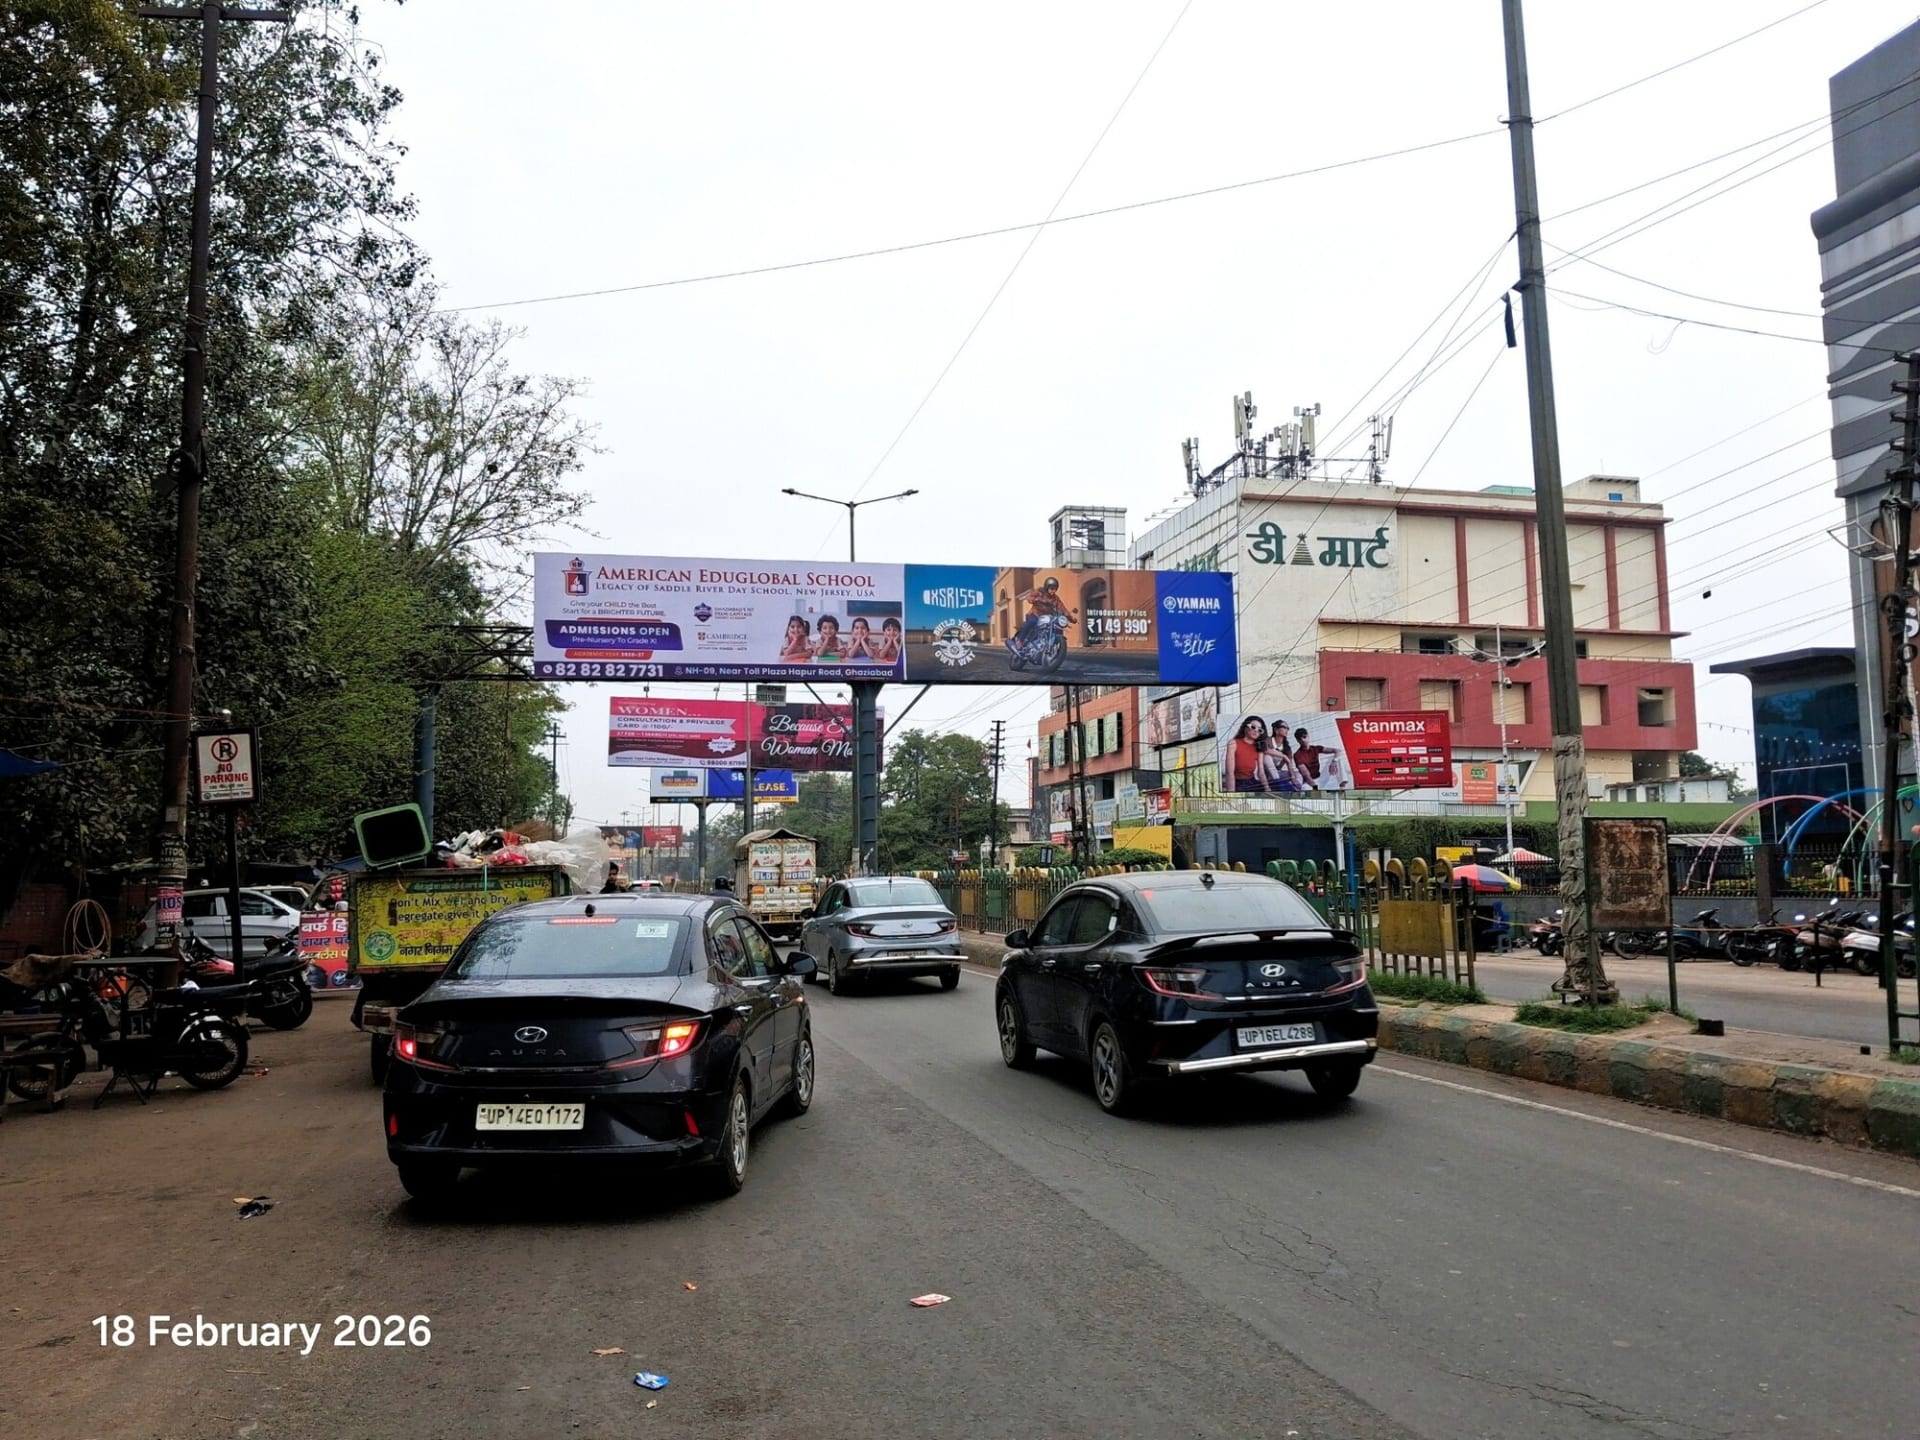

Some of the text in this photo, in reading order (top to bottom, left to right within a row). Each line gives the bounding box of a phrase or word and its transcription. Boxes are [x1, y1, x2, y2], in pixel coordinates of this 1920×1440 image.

[1245, 521, 1389, 569] डी मार्ट
[597, 565, 876, 587] AMERICAN EDUGLOBAL SCHOOL
[596, 582, 634, 591] LEGACY
[637, 583, 650, 592] OF
[654, 584, 691, 593] SADDLE
[695, 585, 724, 593] RIVER
[728, 586, 747, 594] DAY
[796, 588, 817, 596] NEW
[856, 589, 876, 597] USA
[1176, 597, 1221, 610] YAMAHA
[560, 625, 670, 636] ADMISSIONS OPEN
[932, 618, 956, 637] BUILD
[1182, 638, 1217, 657] BLUE
[555, 663, 664, 678] 82 82 82 7731
[719, 667, 741, 675] Near
[743, 668, 760, 676] Toll
[762, 668, 787, 677] Plaza
[788, 669, 817, 678] Hapur
[845, 669, 894, 678] Ghaziabad
[617, 716, 677, 724] CONSULTATION
[768, 714, 824, 733] Because
[1353, 719, 1425, 733] stanmax
[760, 736, 819, 757] Woman
[218, 763, 233, 773] NO
[204, 772, 249, 784] PARKING
[422, 896, 440, 908] Mix
[468, 895, 486, 907] and
[472, 910, 480, 919] it
[399, 942, 453, 957] नगर निगम
[1245, 980, 1301, 988] AURA
